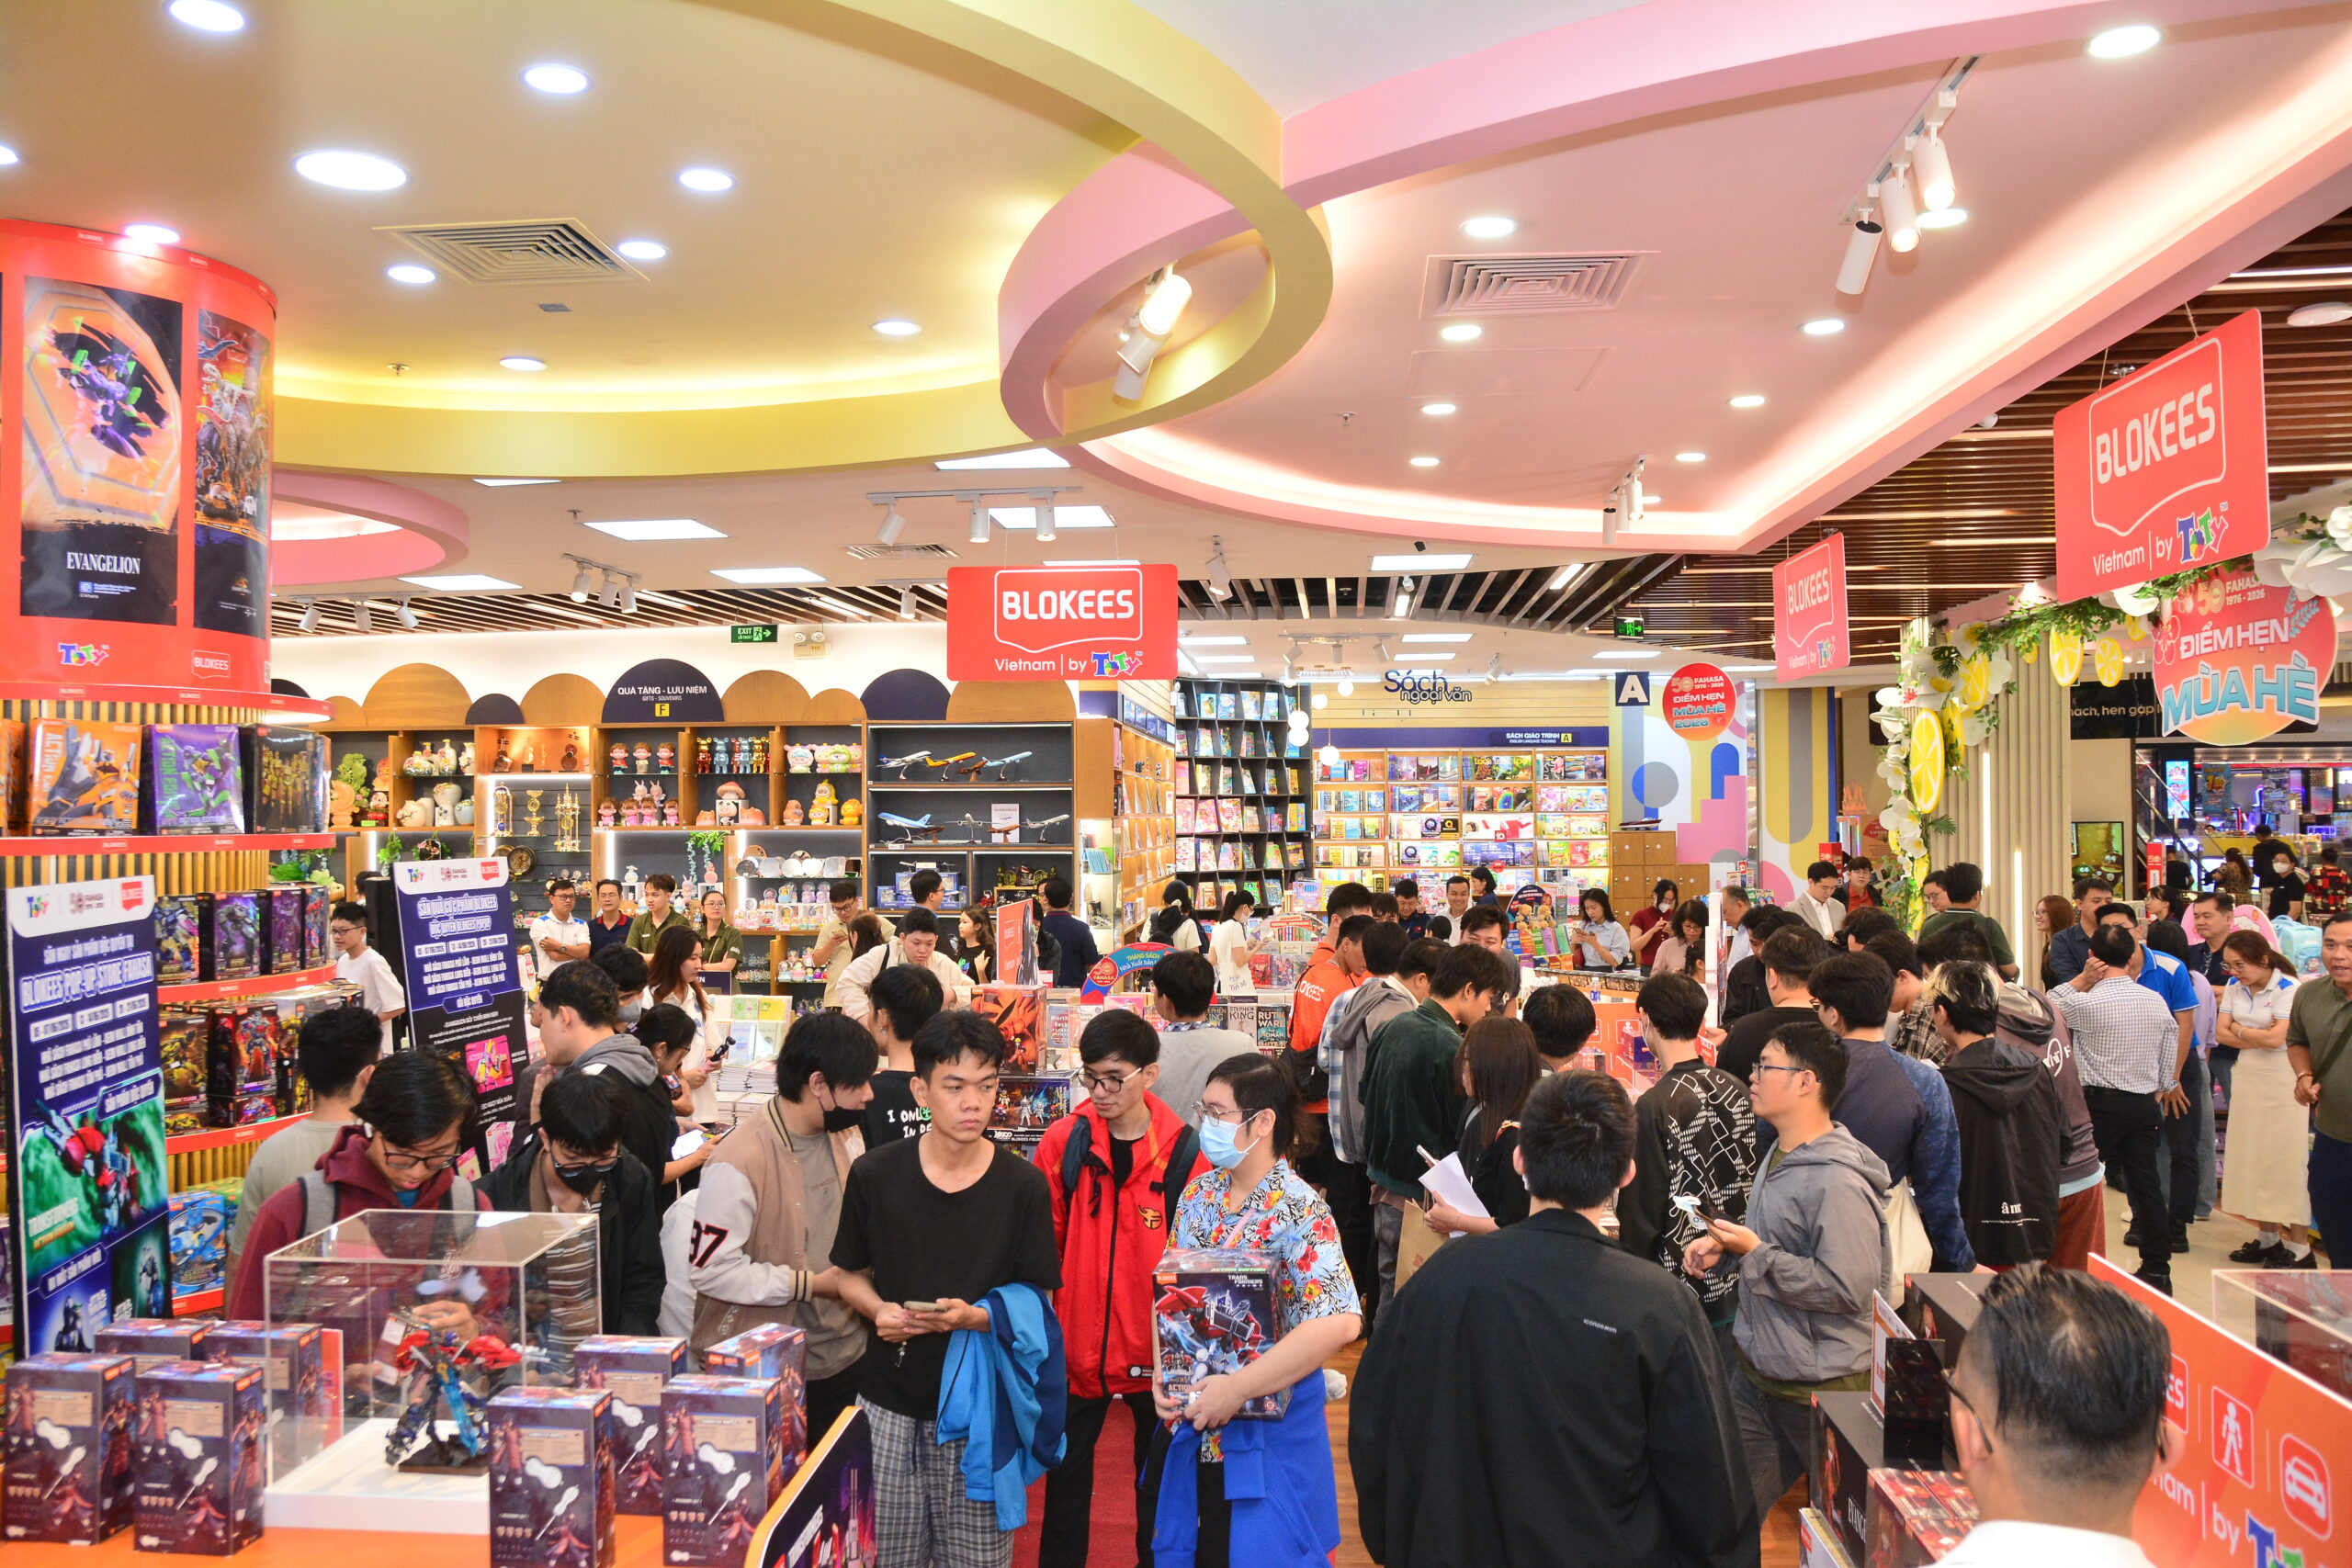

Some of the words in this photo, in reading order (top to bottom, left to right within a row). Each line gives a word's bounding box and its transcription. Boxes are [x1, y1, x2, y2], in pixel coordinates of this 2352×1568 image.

[2096, 382, 2215, 484] BLOKEES
[66, 551, 141, 575] EVANGELION
[2093, 545, 2144, 576] Vietnam
[2155, 536, 2173, 560] by
[1787, 568, 1830, 615] BLOKEES
[2226, 593, 2242, 605] 1976
[2246, 589, 2265, 601] 2026
[1001, 589, 1135, 620] BLOKEES
[2179, 620, 2233, 660] ĐIỂM
[2236, 616, 2290, 652] HẸN
[194, 657, 229, 671] BLOKEES
[994, 658, 1055, 671] Vietnam
[1069, 658, 1087, 673] by
[1384, 669, 1449, 693] Sách
[1618, 674, 1648, 704] A
[1671, 676, 1694, 693] 50
[617, 686, 637, 694] QUÀ
[638, 685, 662, 696] TẶNG
[667, 686, 685, 694] LƯU
[685, 685, 707, 695] NIỆM
[1400, 687, 1442, 705] ngoại
[1445, 687, 1473, 702] văn
[1702, 693, 1724, 703] HẸN
[2162, 660, 2252, 738] MÙA
[2253, 649, 2320, 725] HÈ
[659, 705, 666, 716] F
[1673, 704, 1705, 716] MÙA
[1146, 952, 1160, 960] SÁCH
[1297, 980, 1325, 1002] OKEES
[1229, 1011, 1255, 1021] KING
[1258, 1011, 1285, 1020] RUTH
[1258, 1020, 1285, 1028] WARE
[903, 1125, 917, 1139] IN
[1168, 1383, 1193, 1392] ACTIO
[2212, 1501, 2240, 1556] by
